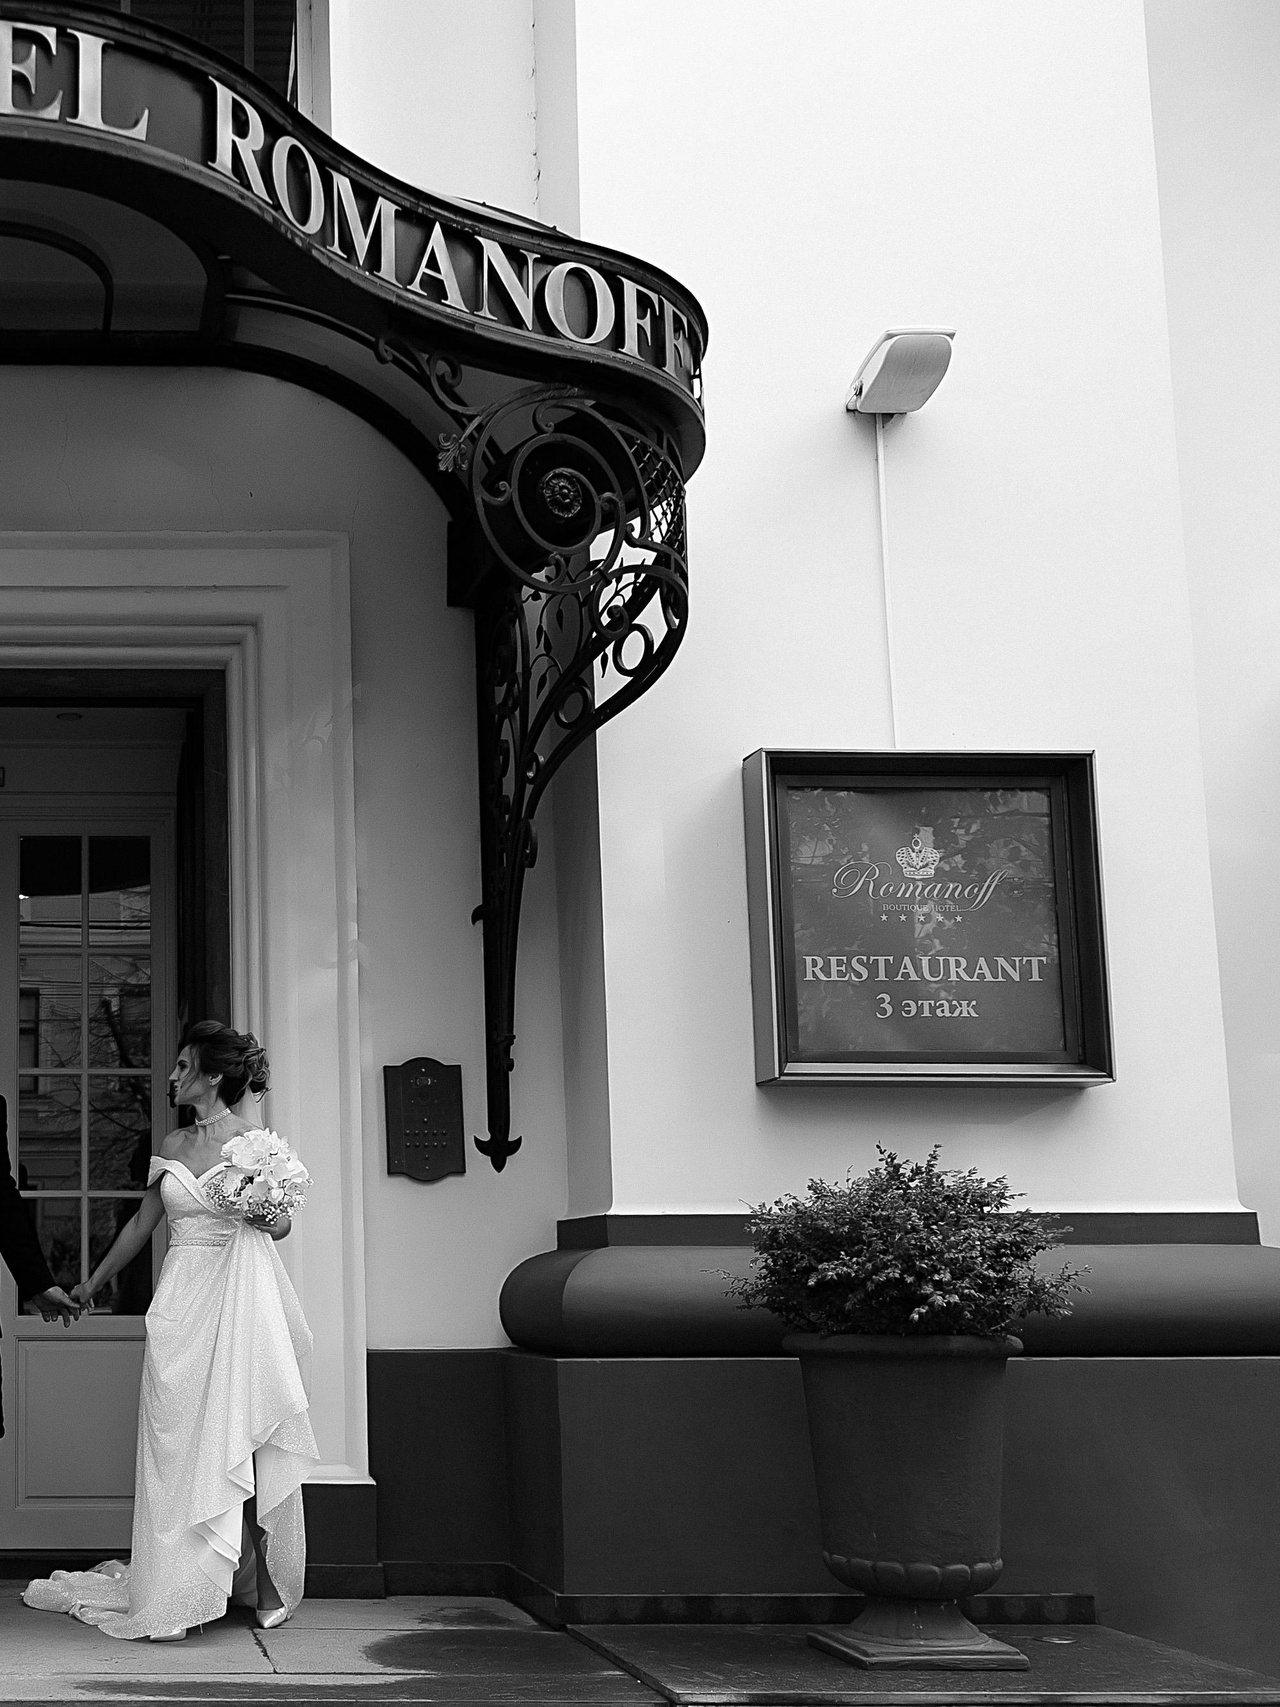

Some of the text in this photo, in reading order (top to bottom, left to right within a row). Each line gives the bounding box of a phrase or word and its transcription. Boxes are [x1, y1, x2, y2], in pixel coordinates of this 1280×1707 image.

[208, 75, 688, 381] ROMANOFF
[831, 860, 1009, 912] Romanoff
[882, 903, 962, 912] BOUTIQUE HOTEL
[802, 955, 1047, 982] RESTAURANT
[875, 992, 979, 1019] 3 этаж
